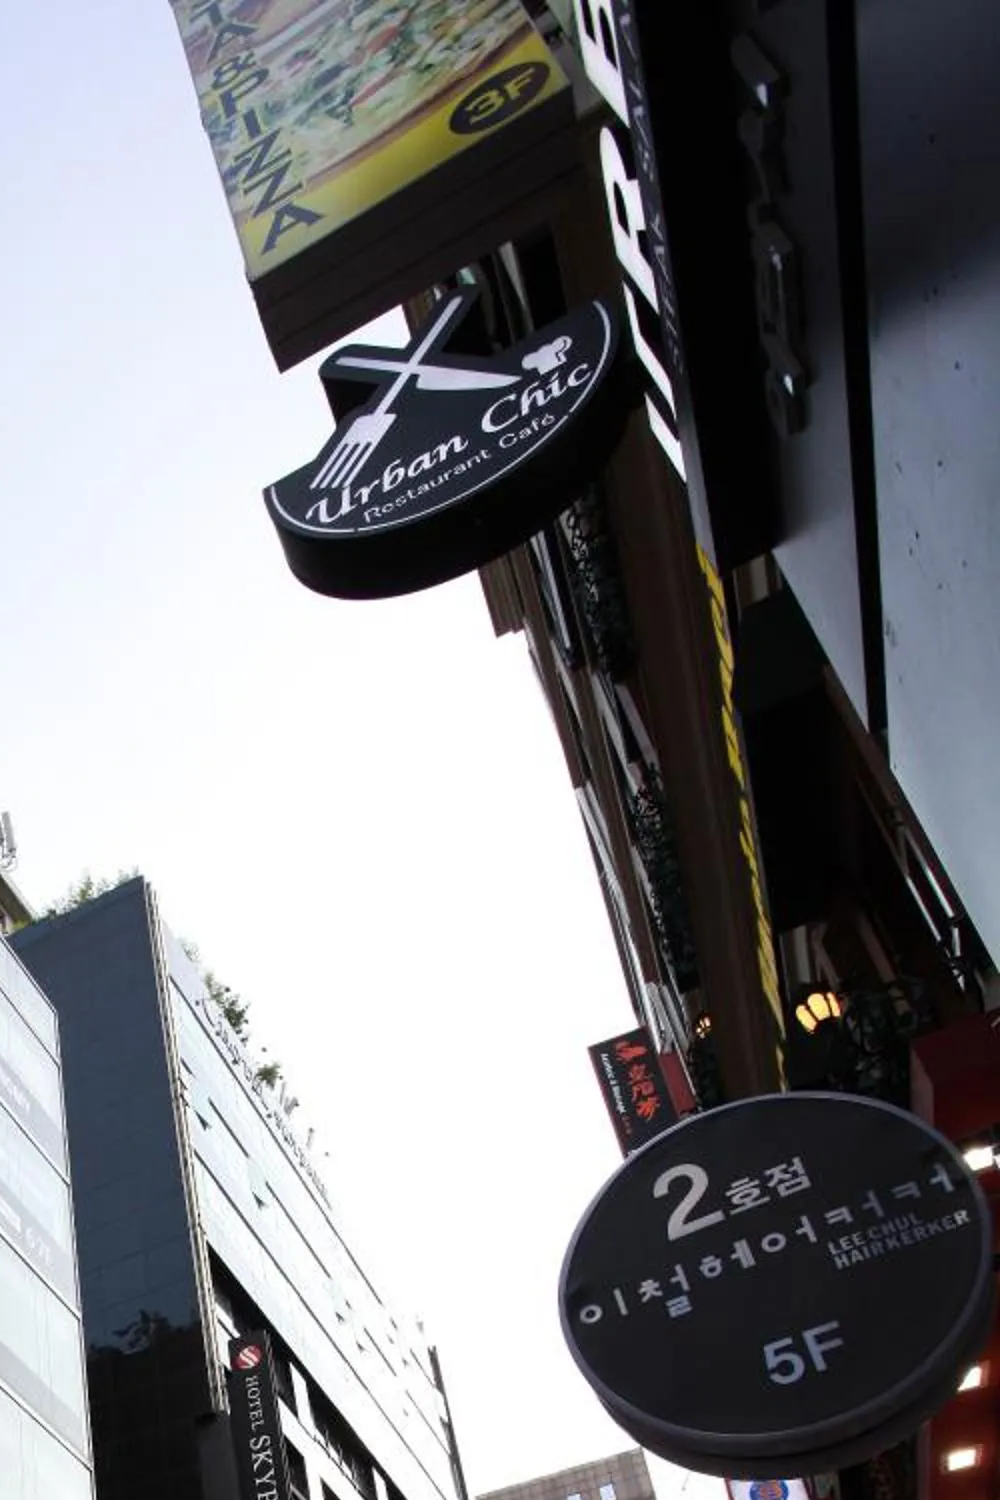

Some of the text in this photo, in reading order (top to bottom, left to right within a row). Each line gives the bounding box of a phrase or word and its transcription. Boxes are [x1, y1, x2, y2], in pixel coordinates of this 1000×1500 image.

[464, 67, 535, 126] 3F
[306, 363, 592, 523] Urban Chic
[362, 448, 493, 523] Restaurant
[652, 1157, 813, 1243] 2호점
[578, 1162, 957, 1325] 이철헤어커커
[828, 1229, 869, 1258] LEE
[832, 1208, 971, 1271] HAIRKERKER
[763, 1321, 846, 1386] 5F
[244, 1375, 265, 1433] HOTEL
